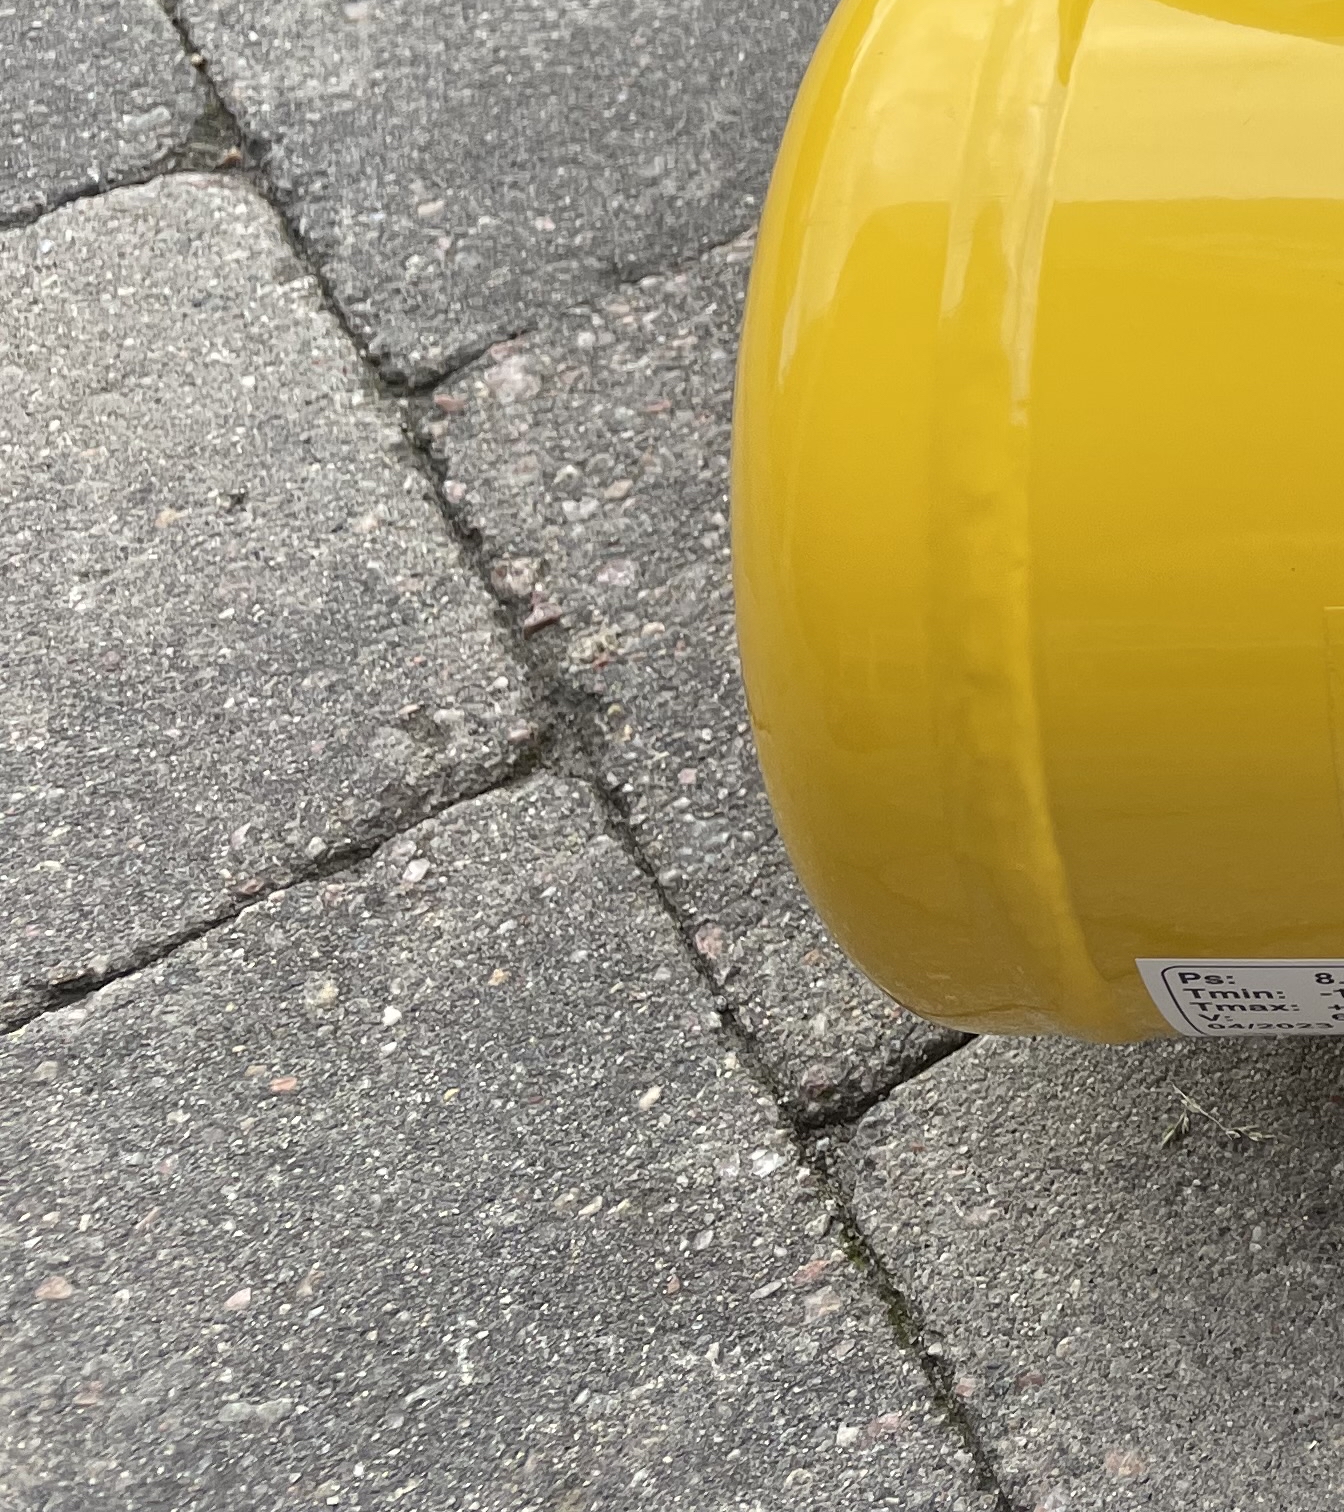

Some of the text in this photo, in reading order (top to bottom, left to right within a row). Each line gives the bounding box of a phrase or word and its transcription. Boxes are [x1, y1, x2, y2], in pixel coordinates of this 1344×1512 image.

[1178, 972, 1235, 985] Ps:
[1182, 988, 1286, 999] Tmin:
[1190, 1002, 1299, 1012] Tmax:
